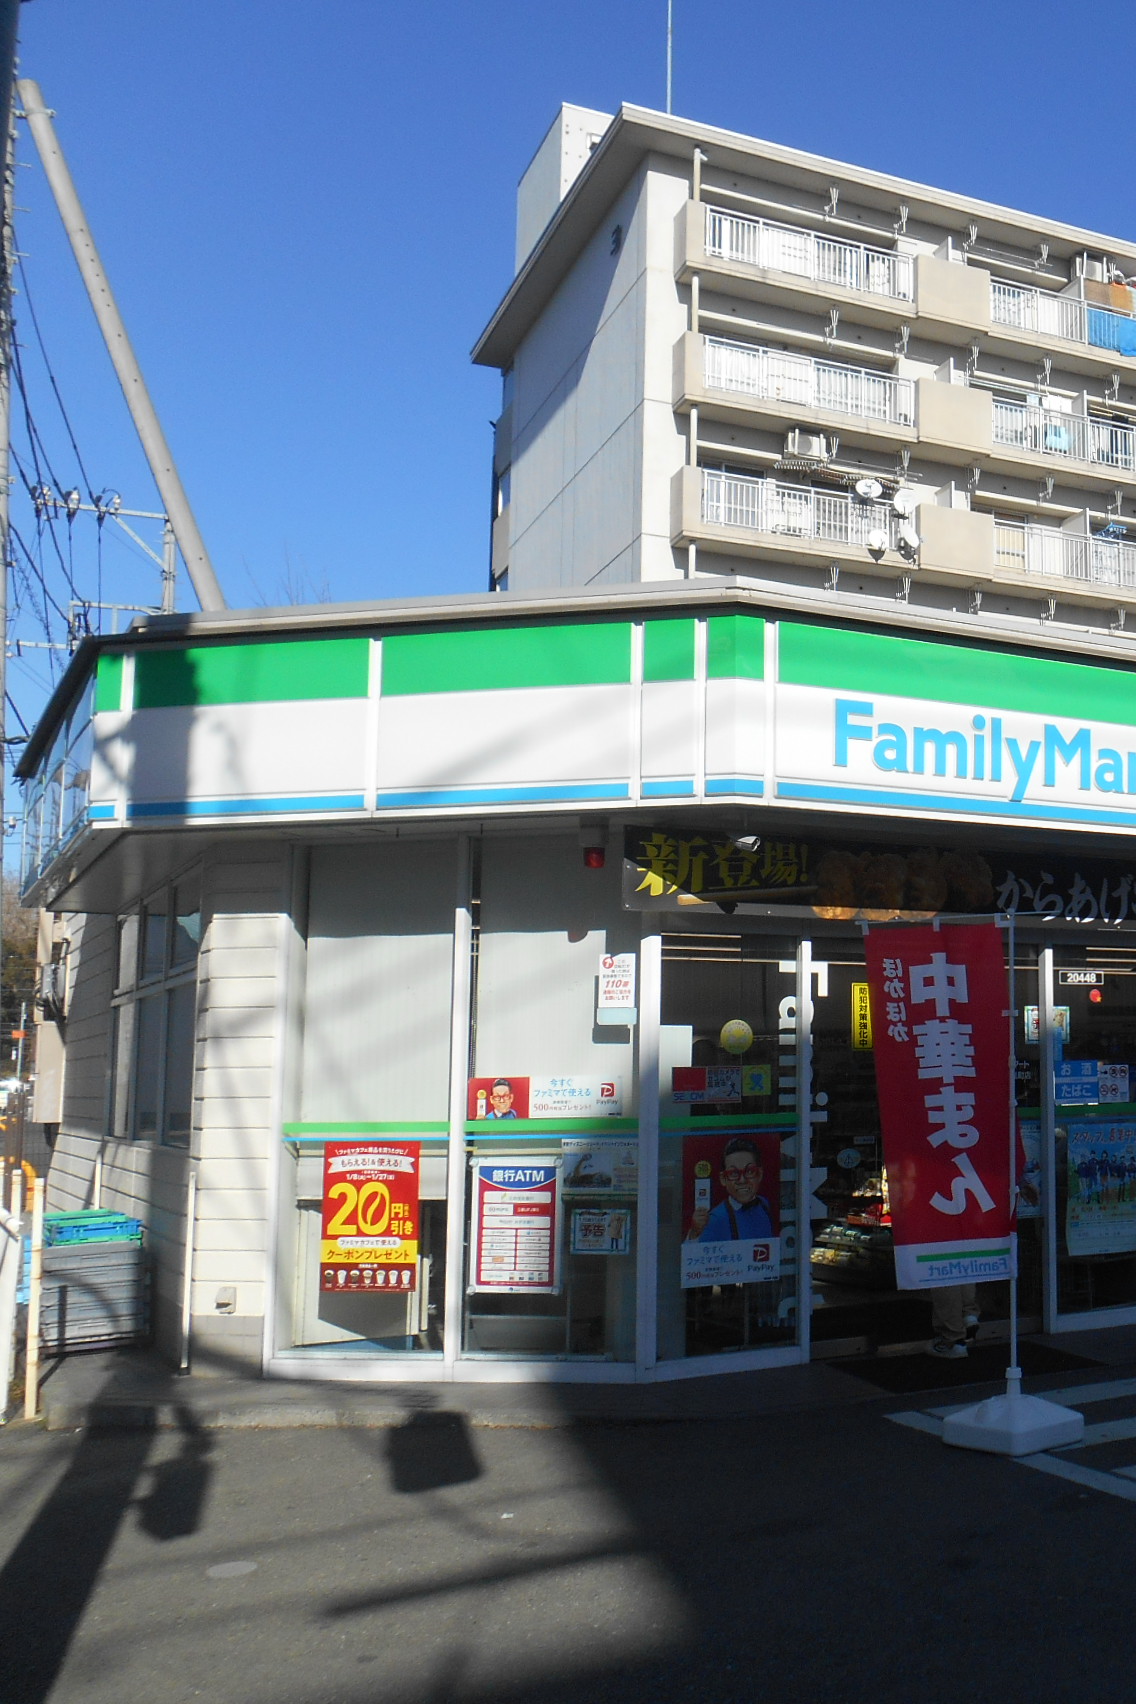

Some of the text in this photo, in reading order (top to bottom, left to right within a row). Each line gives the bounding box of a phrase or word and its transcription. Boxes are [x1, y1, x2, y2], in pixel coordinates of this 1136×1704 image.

[634, 832, 809, 896] 新登場!
[1067, 973, 1097, 983] 20448
[859, 987, 868, 1047] 防犯対策強化中
[550, 1078, 572, 1087] 今すぐ
[534, 1088, 591, 1097] ファミマで使える
[1061, 1085, 1092, 1097] たばこ
[492, 1169, 545, 1182] 銀行ATM
[327, 1182, 390, 1235] 20
[391, 1221, 413, 1235] 引き
[583, 1225, 604, 1237] 予告
[327, 1250, 409, 1260] クーポンプレゼント
[703, 1246, 723, 1254] 今すぐ
[687, 1254, 742, 1265] ファミマで使える
